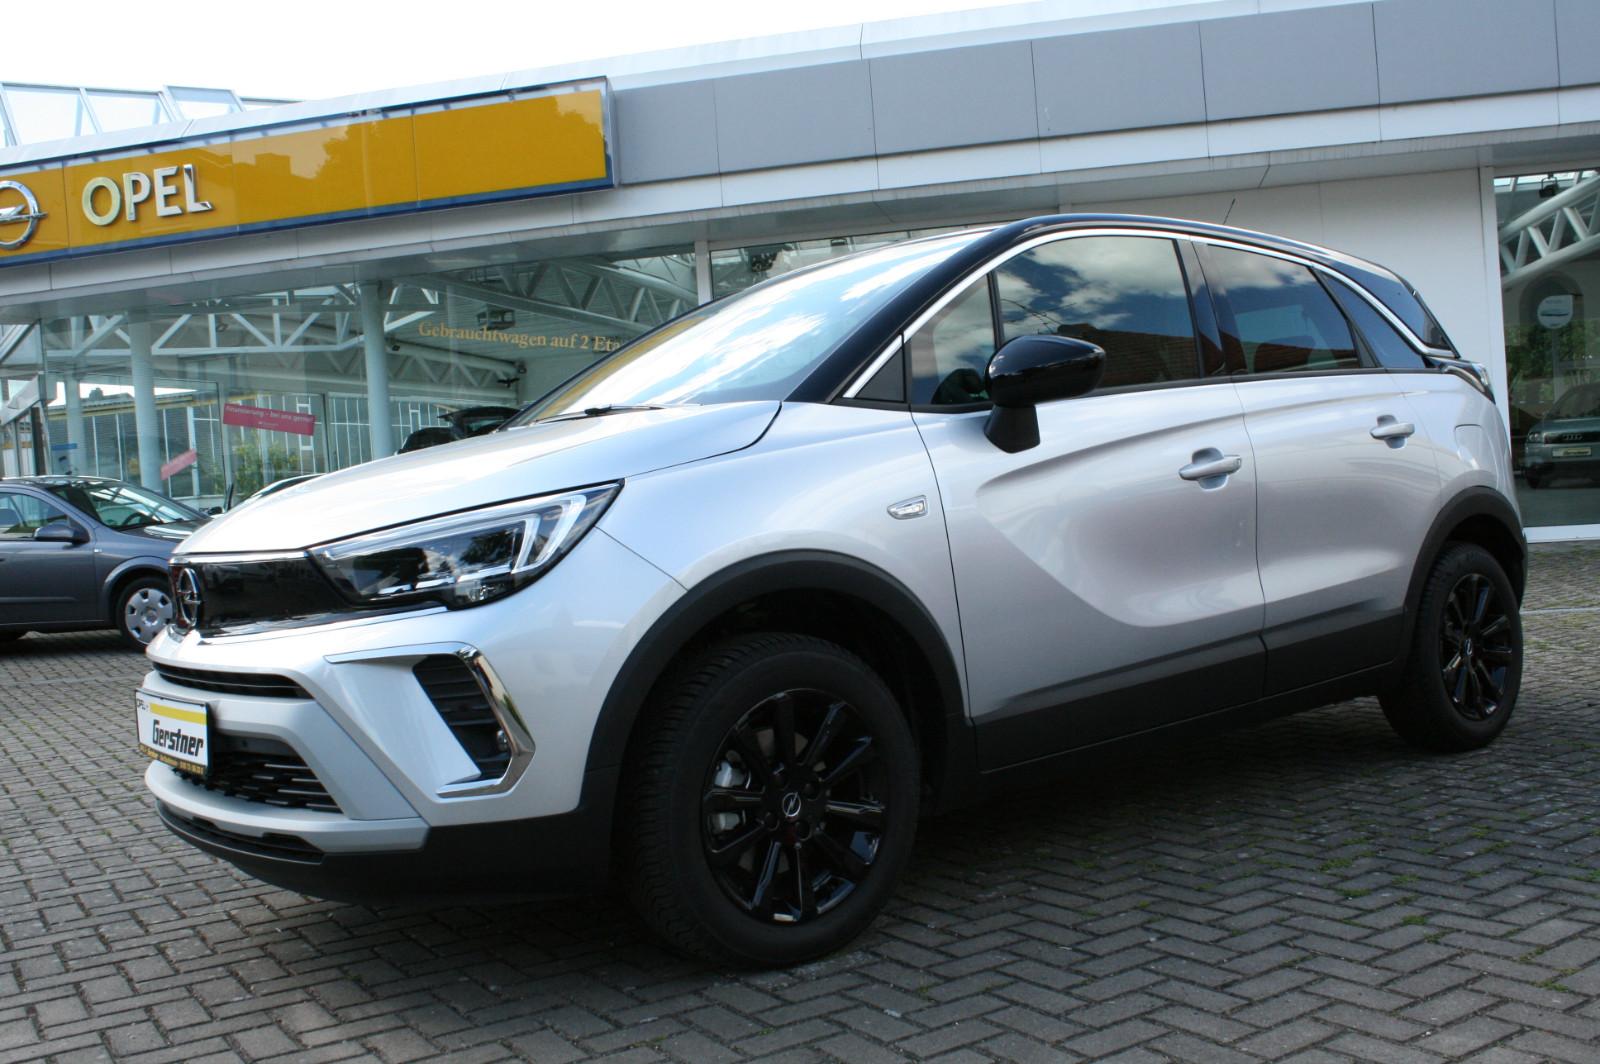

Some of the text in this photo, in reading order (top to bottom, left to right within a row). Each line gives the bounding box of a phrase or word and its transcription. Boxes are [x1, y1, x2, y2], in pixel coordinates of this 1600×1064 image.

[81, 163, 214, 226] OPEL
[418, 321, 546, 349] Gebrauchtwagen
[550, 333, 578, 349] auf
[580, 335, 590, 350] 2
[152, 719, 204, 757] Gerstner
